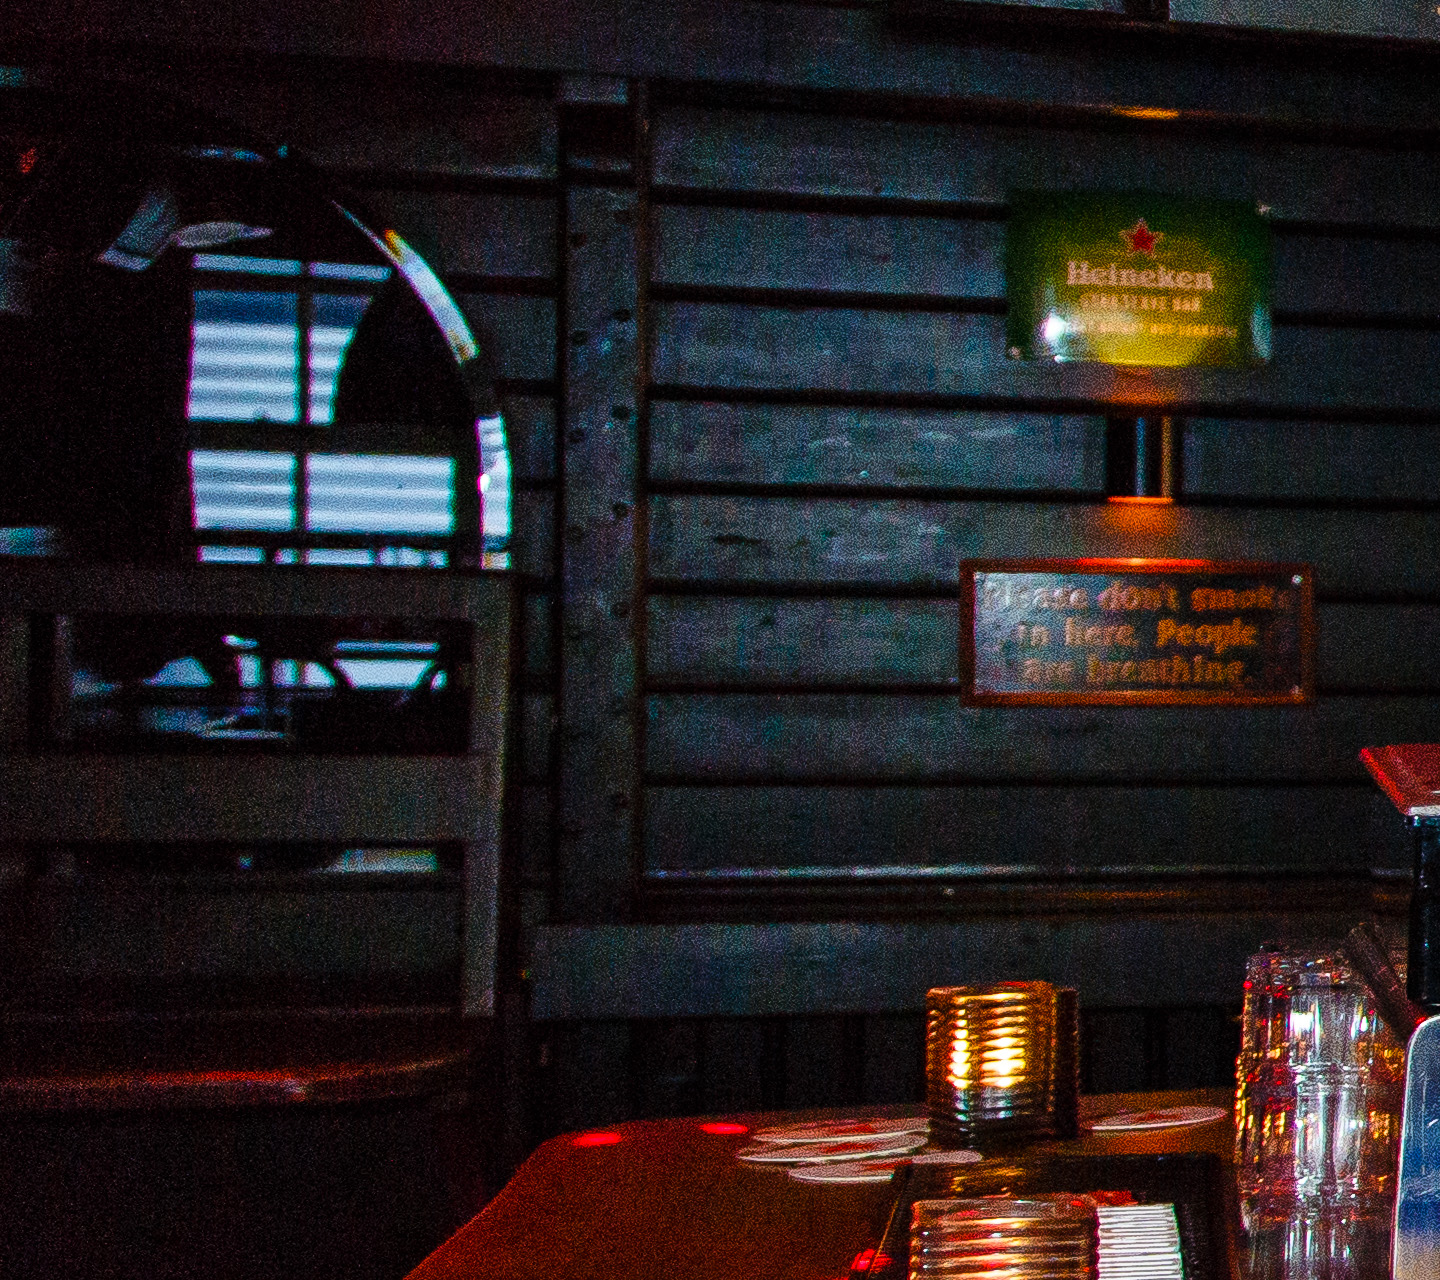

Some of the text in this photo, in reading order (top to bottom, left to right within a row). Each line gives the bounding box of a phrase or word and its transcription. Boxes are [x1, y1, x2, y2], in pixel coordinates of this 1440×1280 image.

[1066, 260, 1214, 290] Heineken
[982, 579, 1293, 611] Please don't smoke
[1016, 620, 1048, 645] in
[1156, 617, 1259, 654] People
[1024, 659, 1074, 682] are
